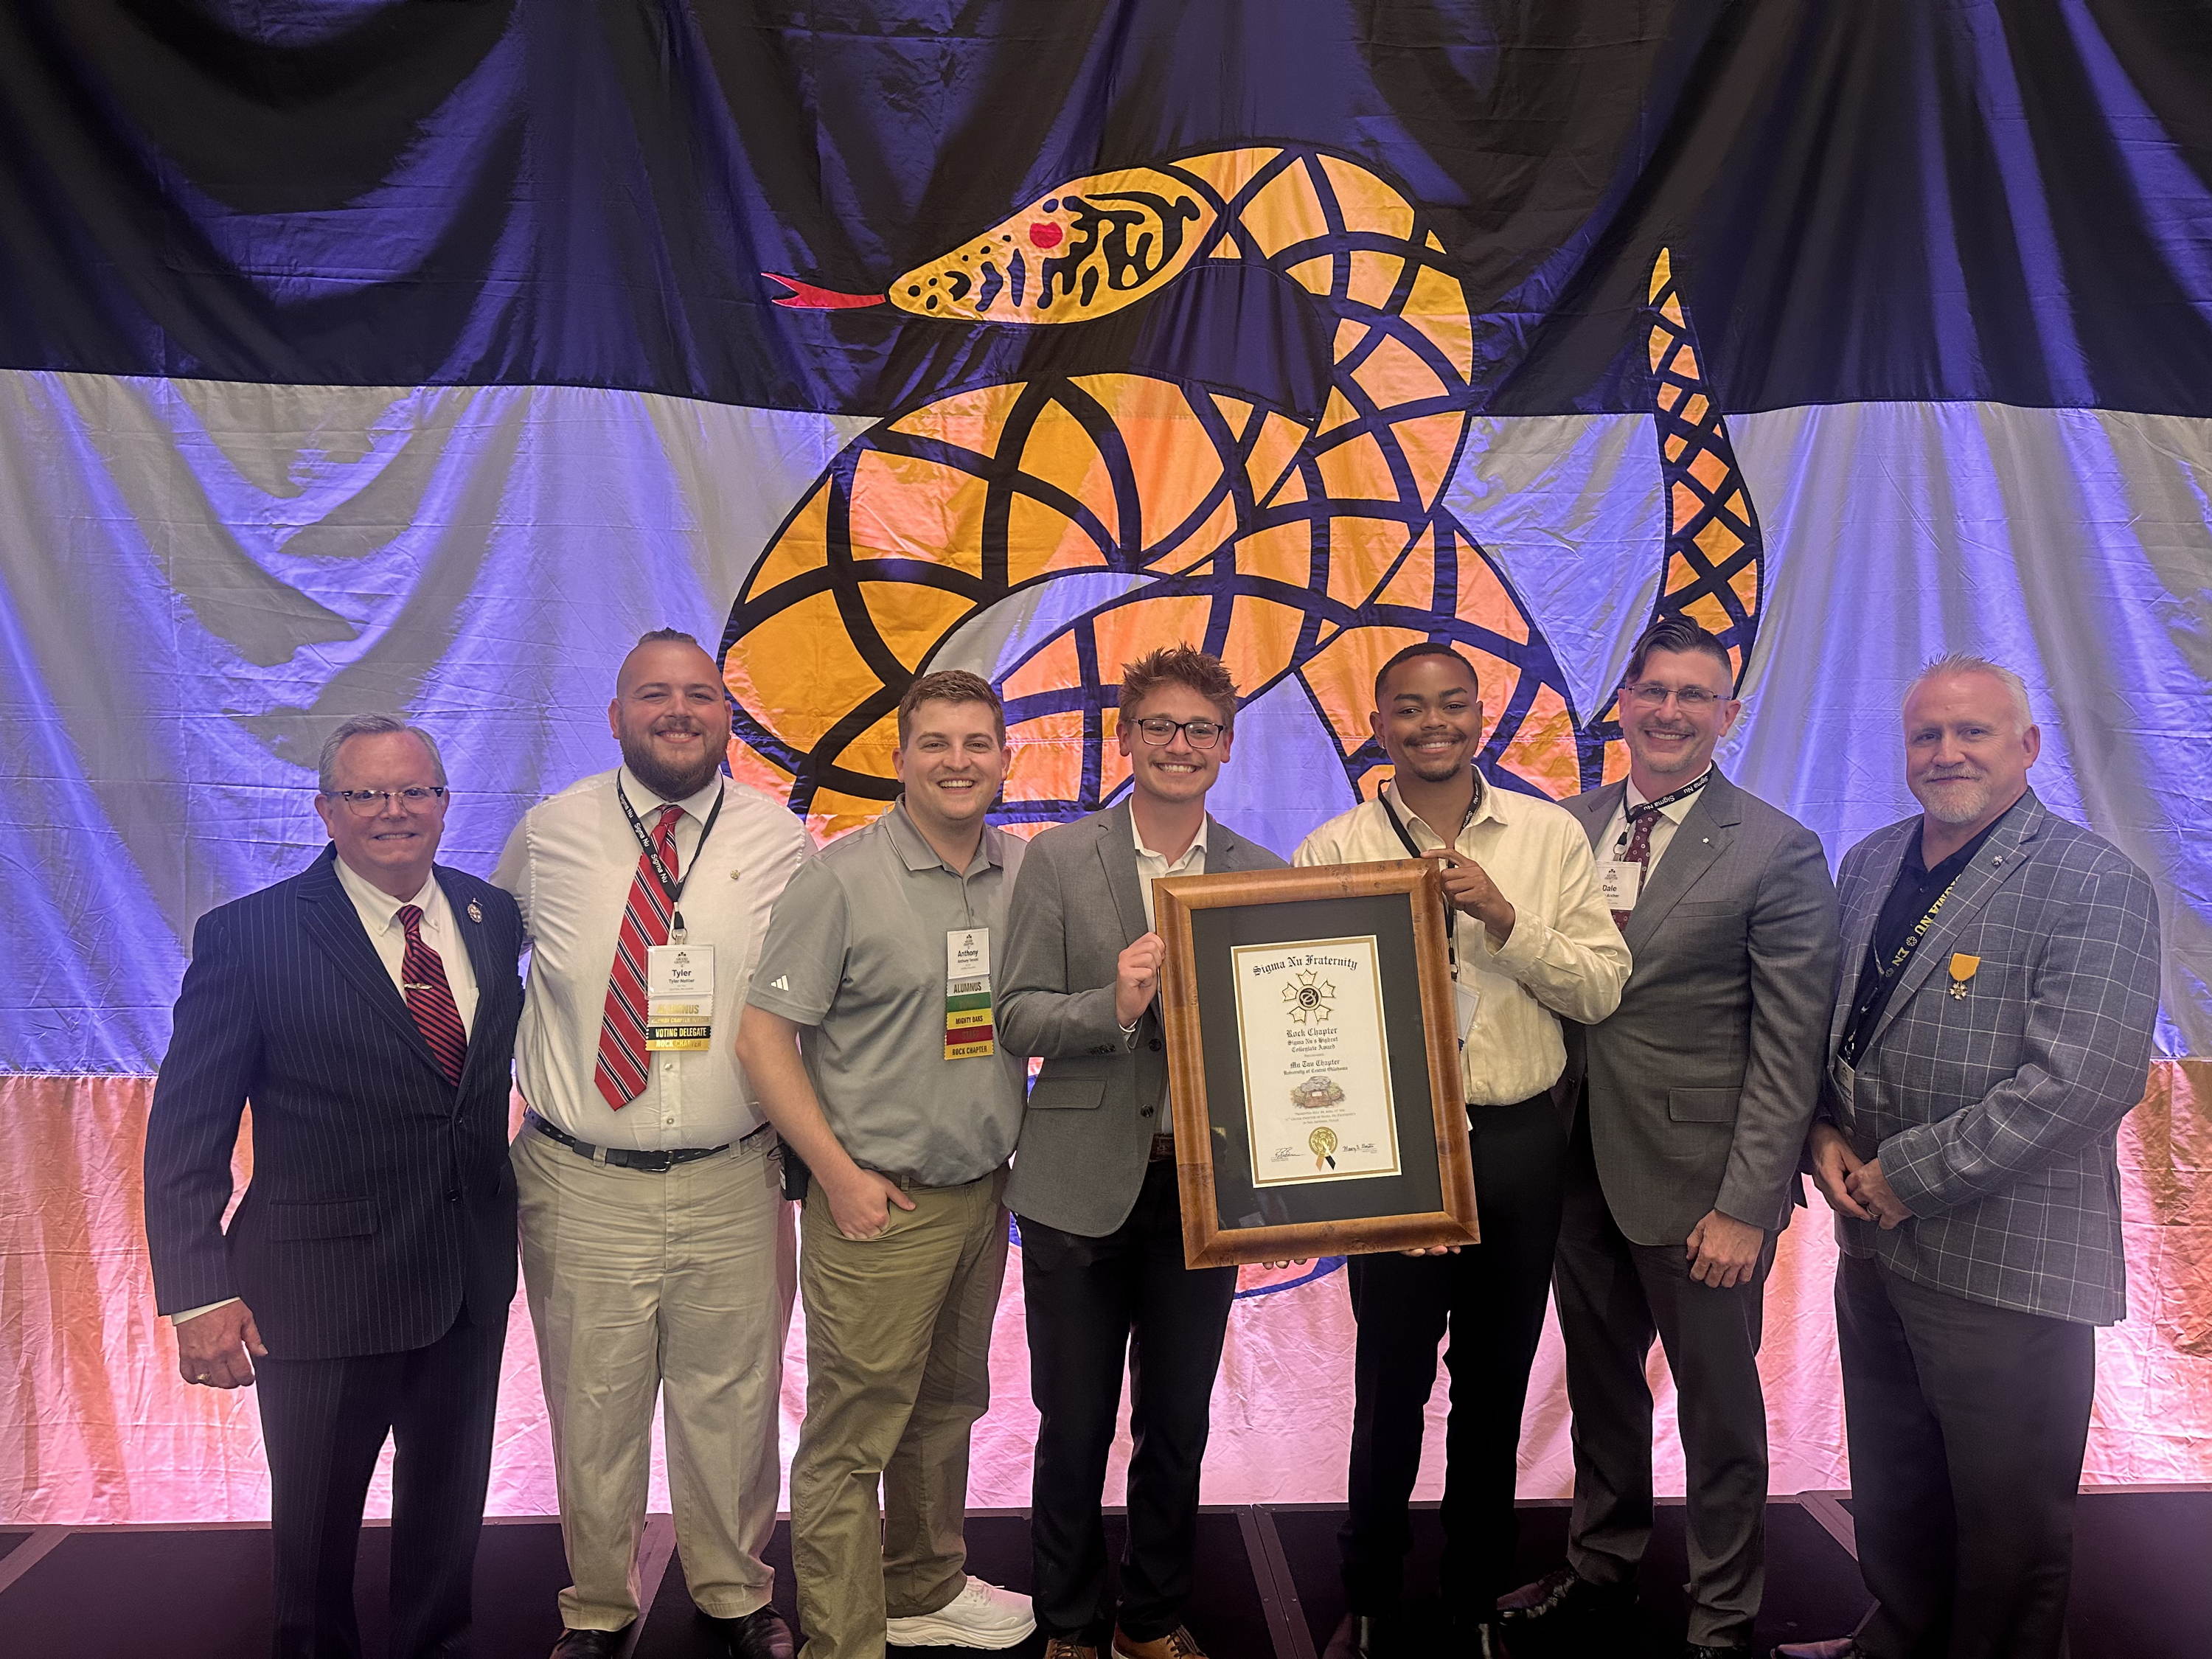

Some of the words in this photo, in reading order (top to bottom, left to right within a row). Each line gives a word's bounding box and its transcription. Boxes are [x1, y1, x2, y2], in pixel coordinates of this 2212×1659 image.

[1694, 776, 1708, 788] Sigma
[1654, 795, 1675, 807] Sigma
[627, 807, 634, 818] Nu
[634, 822, 645, 839] Sigma
[641, 835, 650, 847] Nu
[650, 854, 662, 874] Sigma
[660, 873, 668, 883] Nu
[1914, 914, 1933, 937] NU
[958, 949, 978, 957] Anthony
[1253, 961, 1286, 977] Sigma
[1287, 956, 1302, 967] Nu
[1305, 954, 1357, 971] Fraternity
[672, 969, 692, 978] Tyler
[953, 982, 982, 993] ALUMNUS
[956, 1017, 972, 1025] MIGHTY
[972, 1015, 984, 1023] OAKS
[655, 1028, 678, 1038] VOTING
[678, 1027, 707, 1037] DELEGATE
[1286, 1029, 1306, 1038] Rock
[1307, 1027, 1338, 1037] Chapter
[655, 1040, 673, 1048] ROCK
[952, 1046, 966, 1056] ROCK
[967, 1044, 987, 1054] CHAPTER
[1315, 1059, 1340, 1067] Chapter
